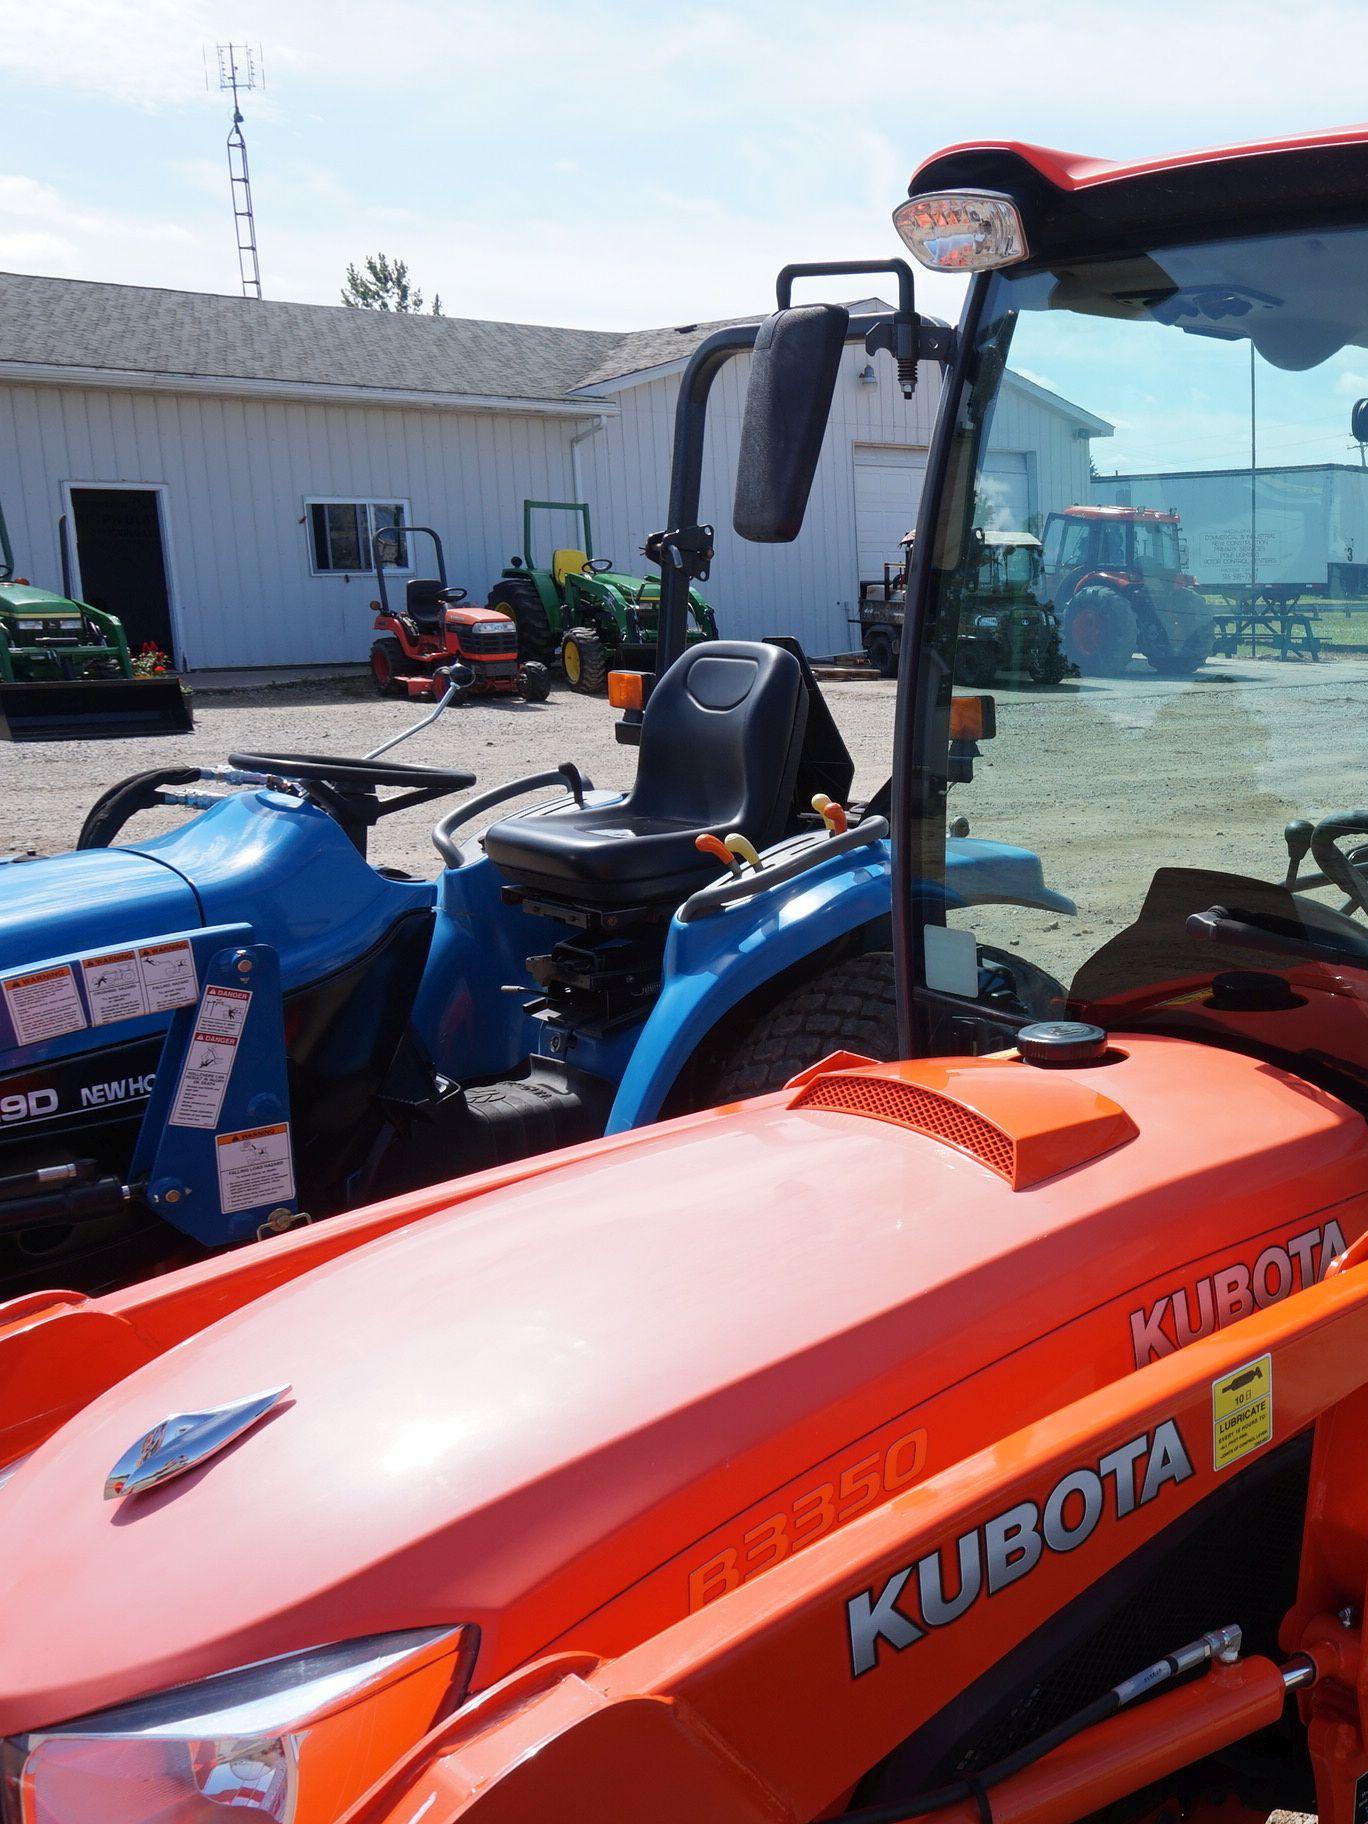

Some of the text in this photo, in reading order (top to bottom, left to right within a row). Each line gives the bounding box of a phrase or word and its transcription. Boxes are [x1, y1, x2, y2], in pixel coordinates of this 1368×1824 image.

[23, 969, 66, 985] WARNING
[217, 989, 249, 1000] DANGER
[205, 1035, 236, 1046] DANGER
[80, 1078, 126, 1107] NEW
[242, 1129, 275, 1140] WARNING
[1129, 1218, 1348, 1371] KUBOTA
[1235, 1394, 1244, 1405] 10
[1219, 1400, 1266, 1434] LUBRICATE
[688, 1428, 928, 1615] B3350
[847, 1416, 1196, 1681] KUBOTA
